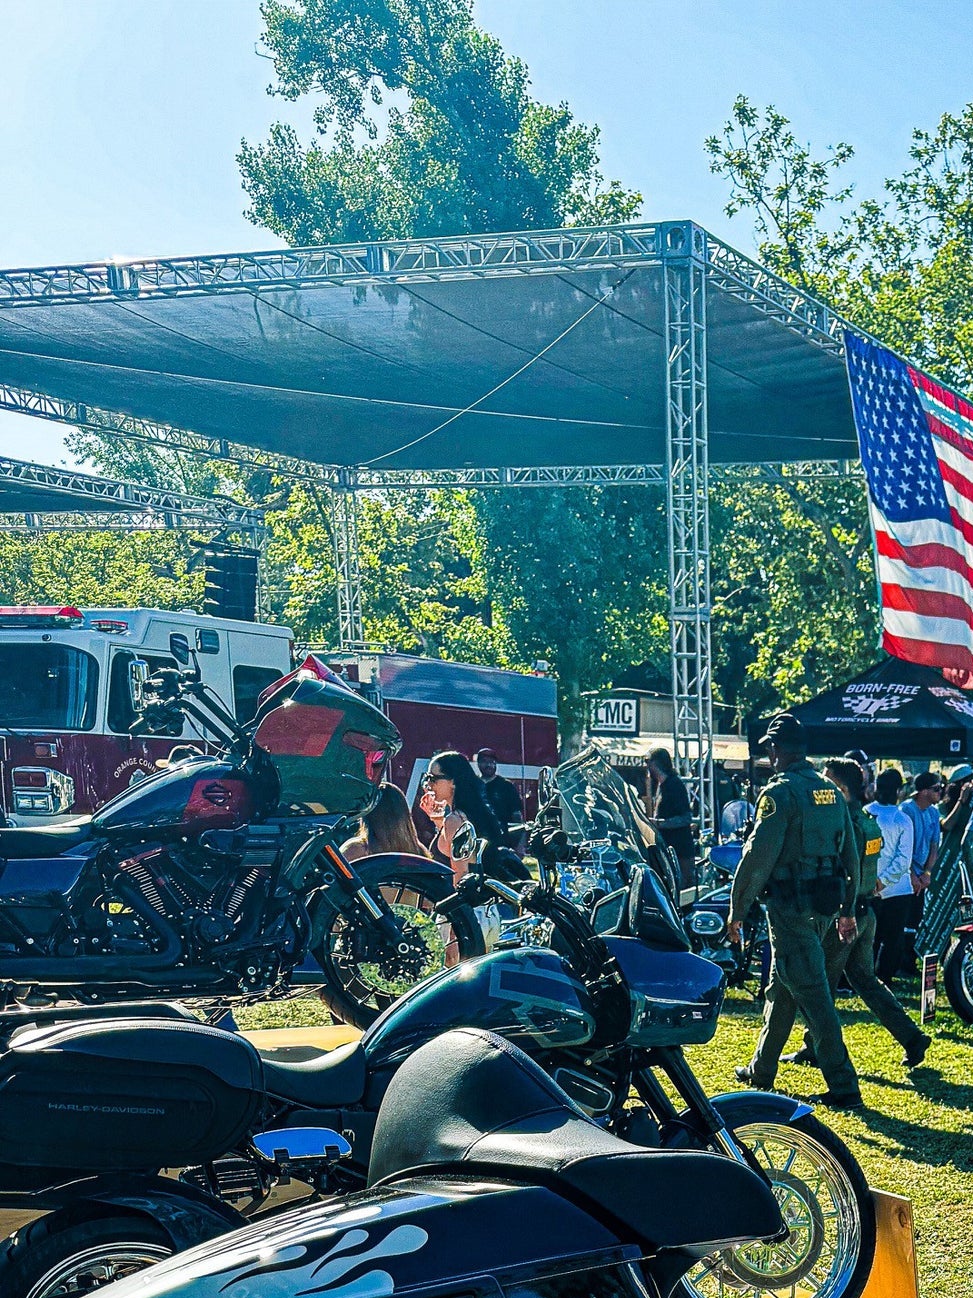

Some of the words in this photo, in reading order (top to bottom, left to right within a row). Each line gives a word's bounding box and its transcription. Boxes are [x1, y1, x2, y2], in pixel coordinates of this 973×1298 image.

[846, 683, 921, 695] BORN-FREE
[113, 757, 138, 778] ORANGE
[138, 758, 157, 773] COUN
[48, 1102, 165, 1115] HARLEY-DAVIDSON
